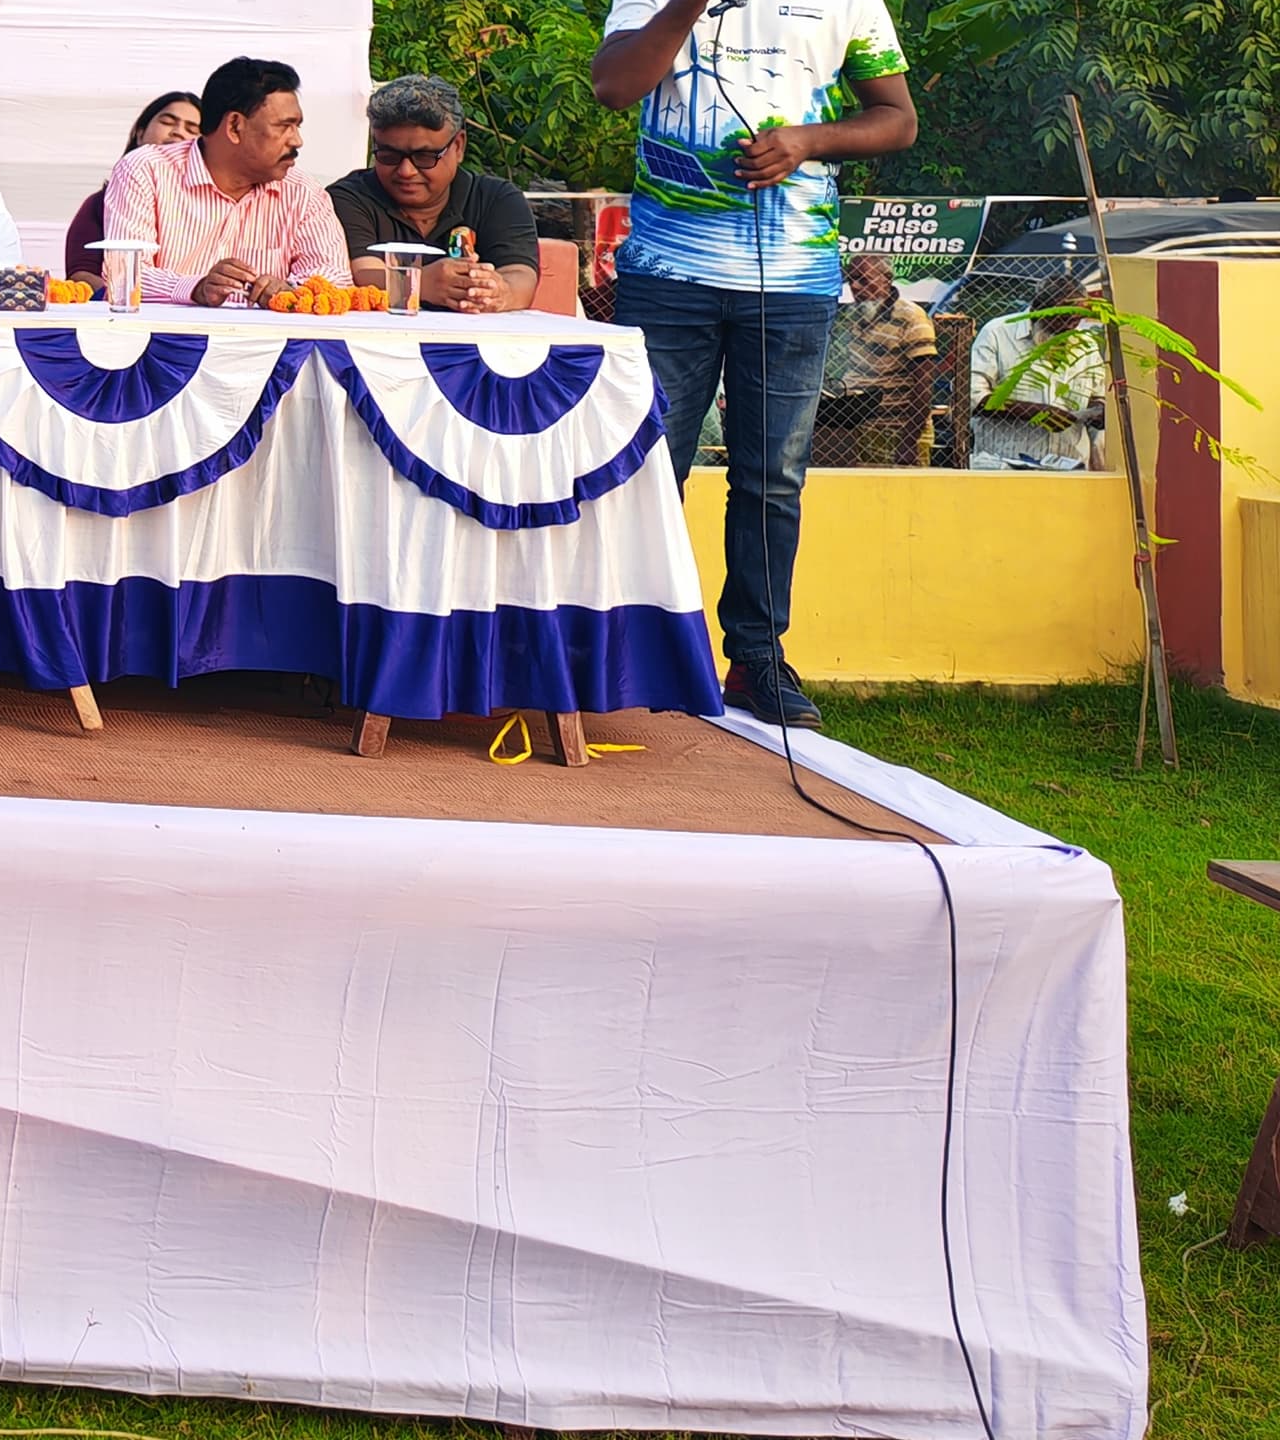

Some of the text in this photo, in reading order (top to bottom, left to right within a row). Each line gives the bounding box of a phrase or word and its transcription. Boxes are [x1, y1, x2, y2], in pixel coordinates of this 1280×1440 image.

[725, 46, 787, 55] Renewables
[871, 202, 907, 217] No
[911, 202, 938, 217] to
[863, 217, 939, 235] False
